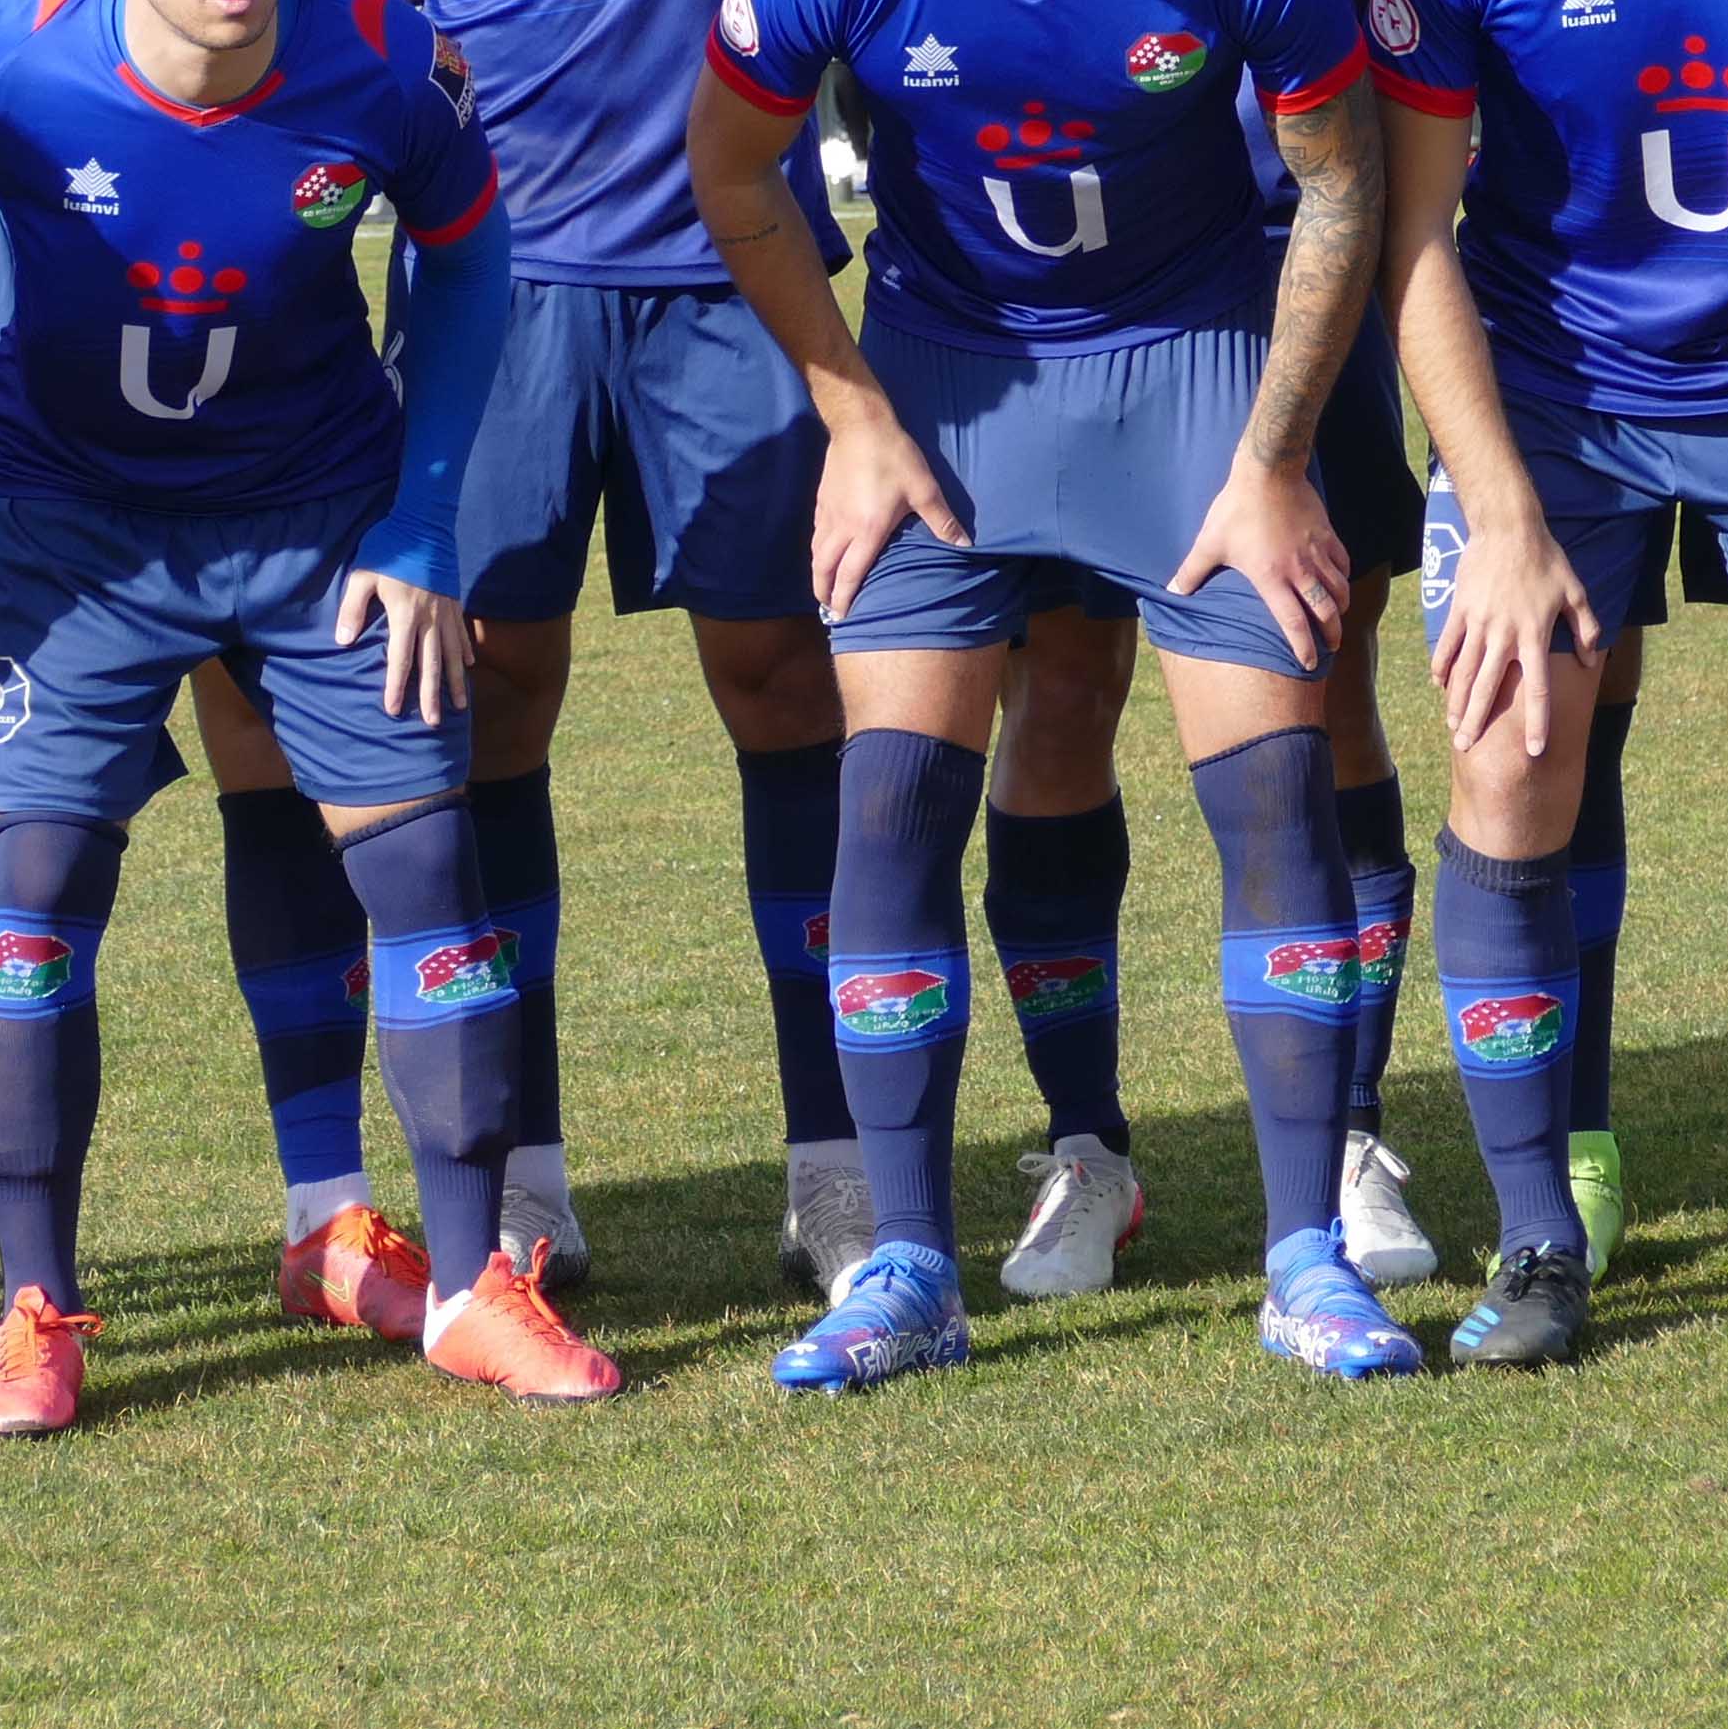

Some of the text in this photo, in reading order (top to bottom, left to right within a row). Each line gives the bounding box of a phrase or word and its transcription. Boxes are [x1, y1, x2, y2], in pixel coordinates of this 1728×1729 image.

[1560, 9, 1618, 28] luanvi
[903, 74, 960, 88] luanvi
[63, 197, 120, 216] luanvi
